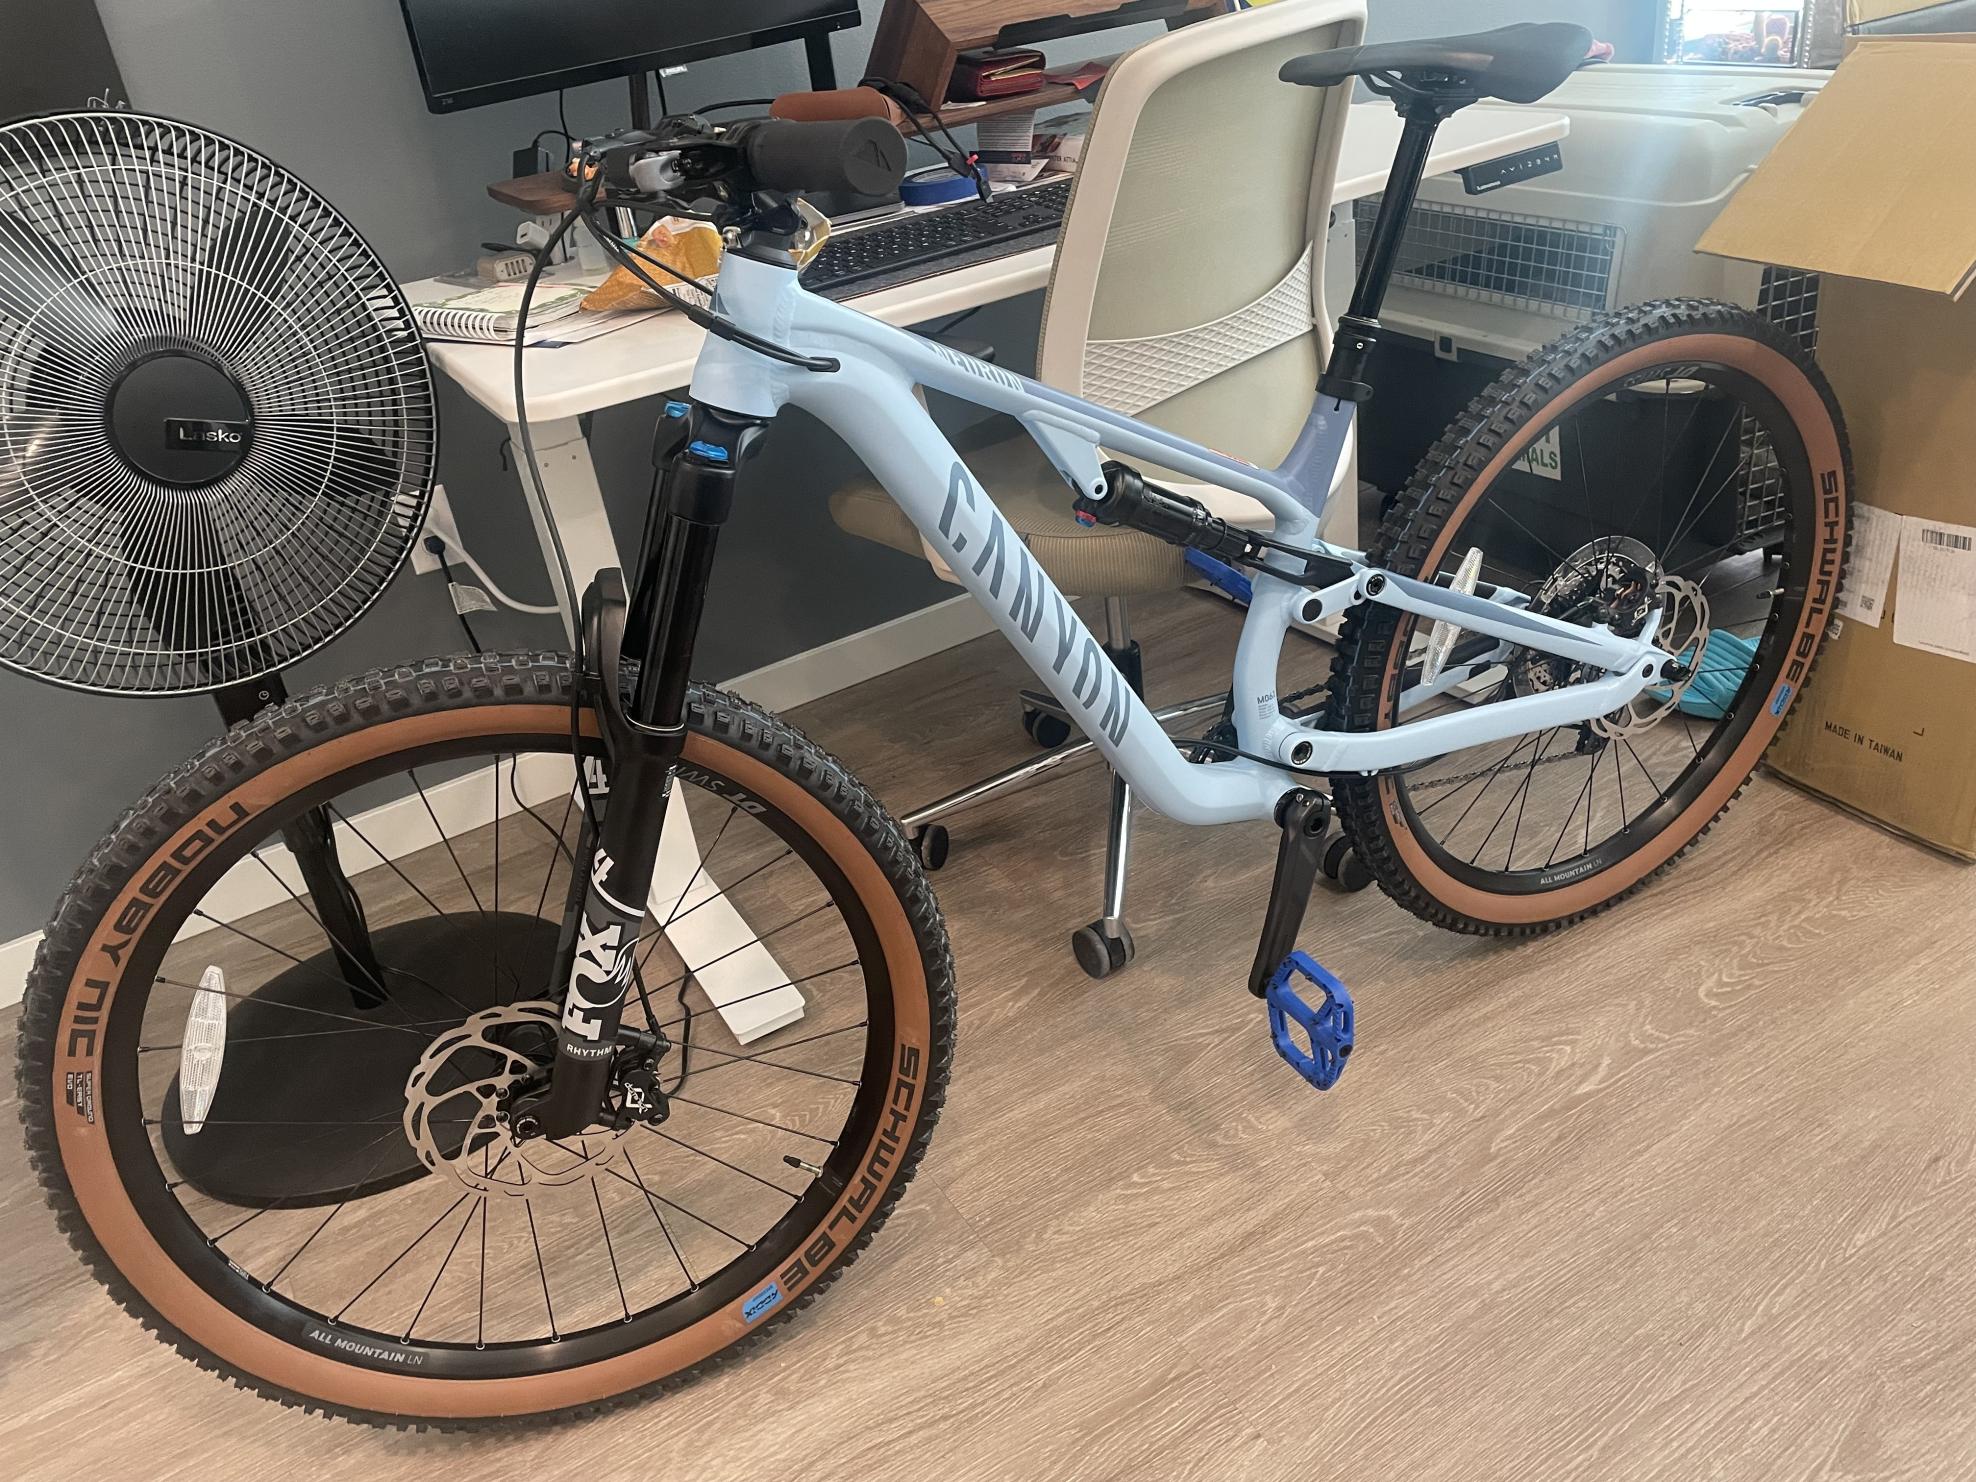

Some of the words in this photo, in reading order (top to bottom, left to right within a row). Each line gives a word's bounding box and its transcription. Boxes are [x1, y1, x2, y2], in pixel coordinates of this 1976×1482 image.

[179, 426, 242, 443] Lasko
[938, 461, 1131, 748] CANYON
[1786, 470, 1840, 684] SCHWALBE
[1824, 721, 1850, 739] MADE
[1853, 732, 1865, 746] IN
[1868, 738, 1904, 762] TAIWAN
[721, 792, 768, 814] DT
[99, 801, 250, 968] NOBBY
[1540, 876, 1553, 885] ALL
[1554, 863, 1592, 881] MOUNTAIN
[561, 911, 639, 1041] FOX
[67, 978, 111, 1057] NIC
[566, 1043, 613, 1057] RHYTHM
[780, 1043, 920, 1292] SCHWALBE
[309, 1330, 332, 1344] ALL
[334, 1338, 406, 1362] MOUNTAIN
[407, 1355, 423, 1365] LN
